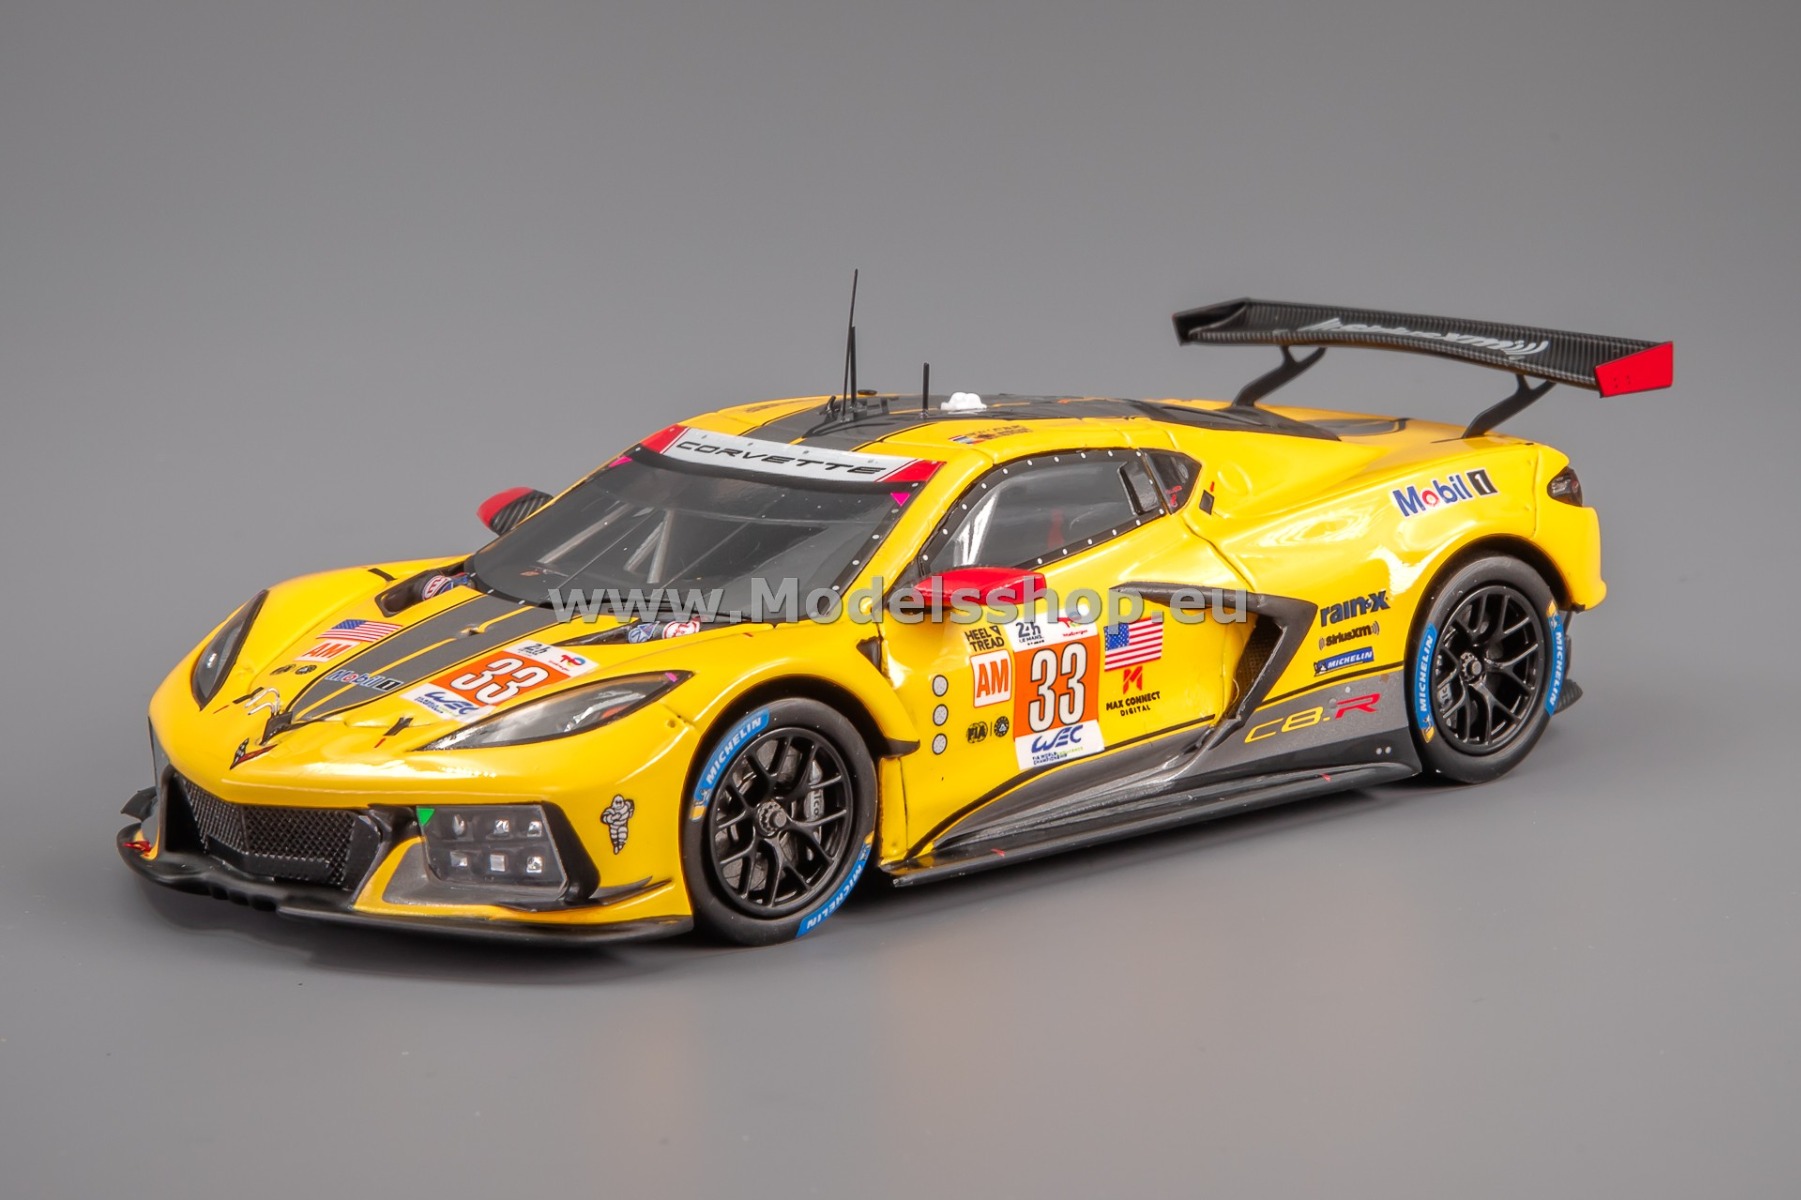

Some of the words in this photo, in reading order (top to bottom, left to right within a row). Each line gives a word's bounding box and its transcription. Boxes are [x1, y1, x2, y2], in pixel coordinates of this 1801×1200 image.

[676, 441, 887, 475] CORVETTE
[1391, 474, 1474, 517] Mobil
[1470, 471, 1494, 495] 1
[965, 627, 992, 641] HEEL
[970, 637, 1005, 652] TREAD
[1016, 620, 1041, 638] 24h
[301, 642, 353, 658] AM
[1327, 650, 1373, 669] MICHELIN
[325, 669, 383, 688] Mobil
[450, 657, 549, 705] 33
[976, 658, 1009, 698] AM
[1419, 635, 1433, 712] MICHELIN
[1550, 631, 1564, 706] MICHELIN
[1028, 641, 1087, 733] 33
[1106, 699, 1124, 711] MAX
[1125, 691, 1160, 706] CONNECT
[424, 691, 479, 715] WEC
[1120, 704, 1151, 717] DIGITAL
[1244, 692, 1381, 743] C8.R
[706, 716, 762, 785] MICHELIN
[1031, 724, 1083, 753] WEC
[806, 864, 863, 930] MICHELIN
